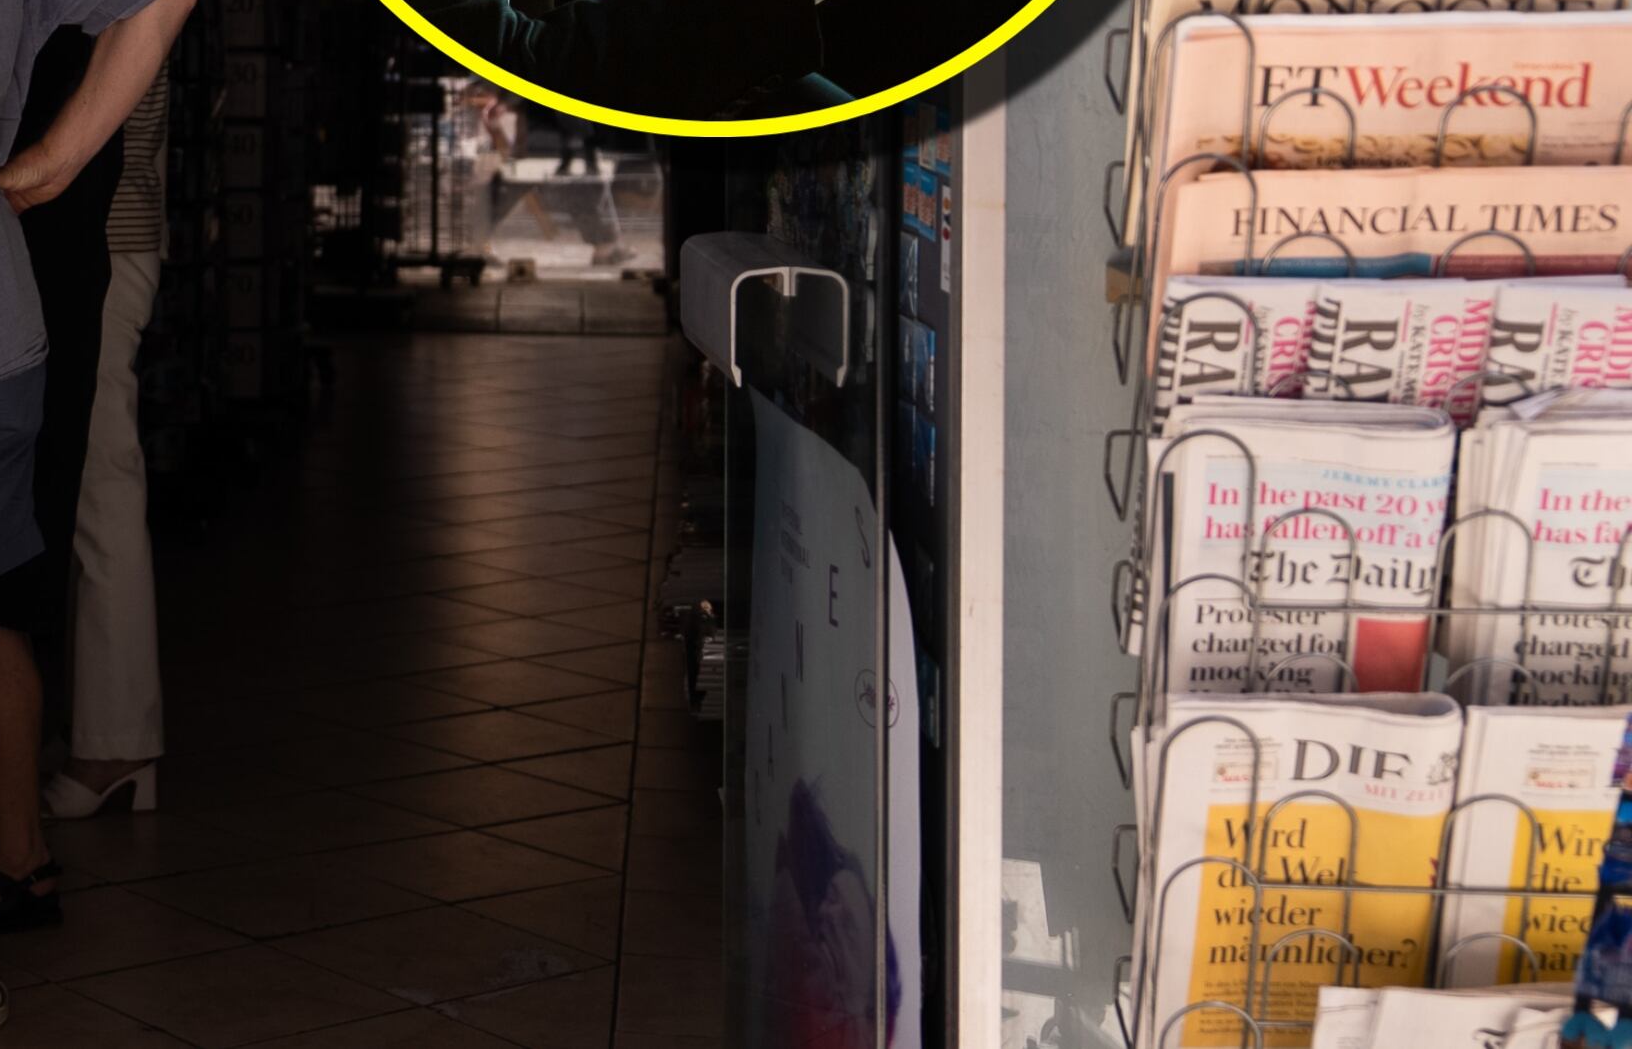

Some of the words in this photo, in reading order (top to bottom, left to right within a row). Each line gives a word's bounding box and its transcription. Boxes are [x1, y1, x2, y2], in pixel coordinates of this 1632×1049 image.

[1231, 203, 1467, 237] FINANCIAL
[1481, 202, 1623, 234] TIMES
[1207, 482, 1240, 506] In
[1249, 481, 1298, 506] he
[1302, 490, 1366, 513] past
[1375, 493, 1419, 518] 20
[1538, 487, 1573, 512] In
[1579, 488, 1632, 512] the
[1354, 523, 1402, 547] off
[1405, 532, 1421, 549] a
[1532, 519, 1589, 545] has
[1326, 553, 1437, 596] Daily
[1224, 817, 1307, 849] Wrd
